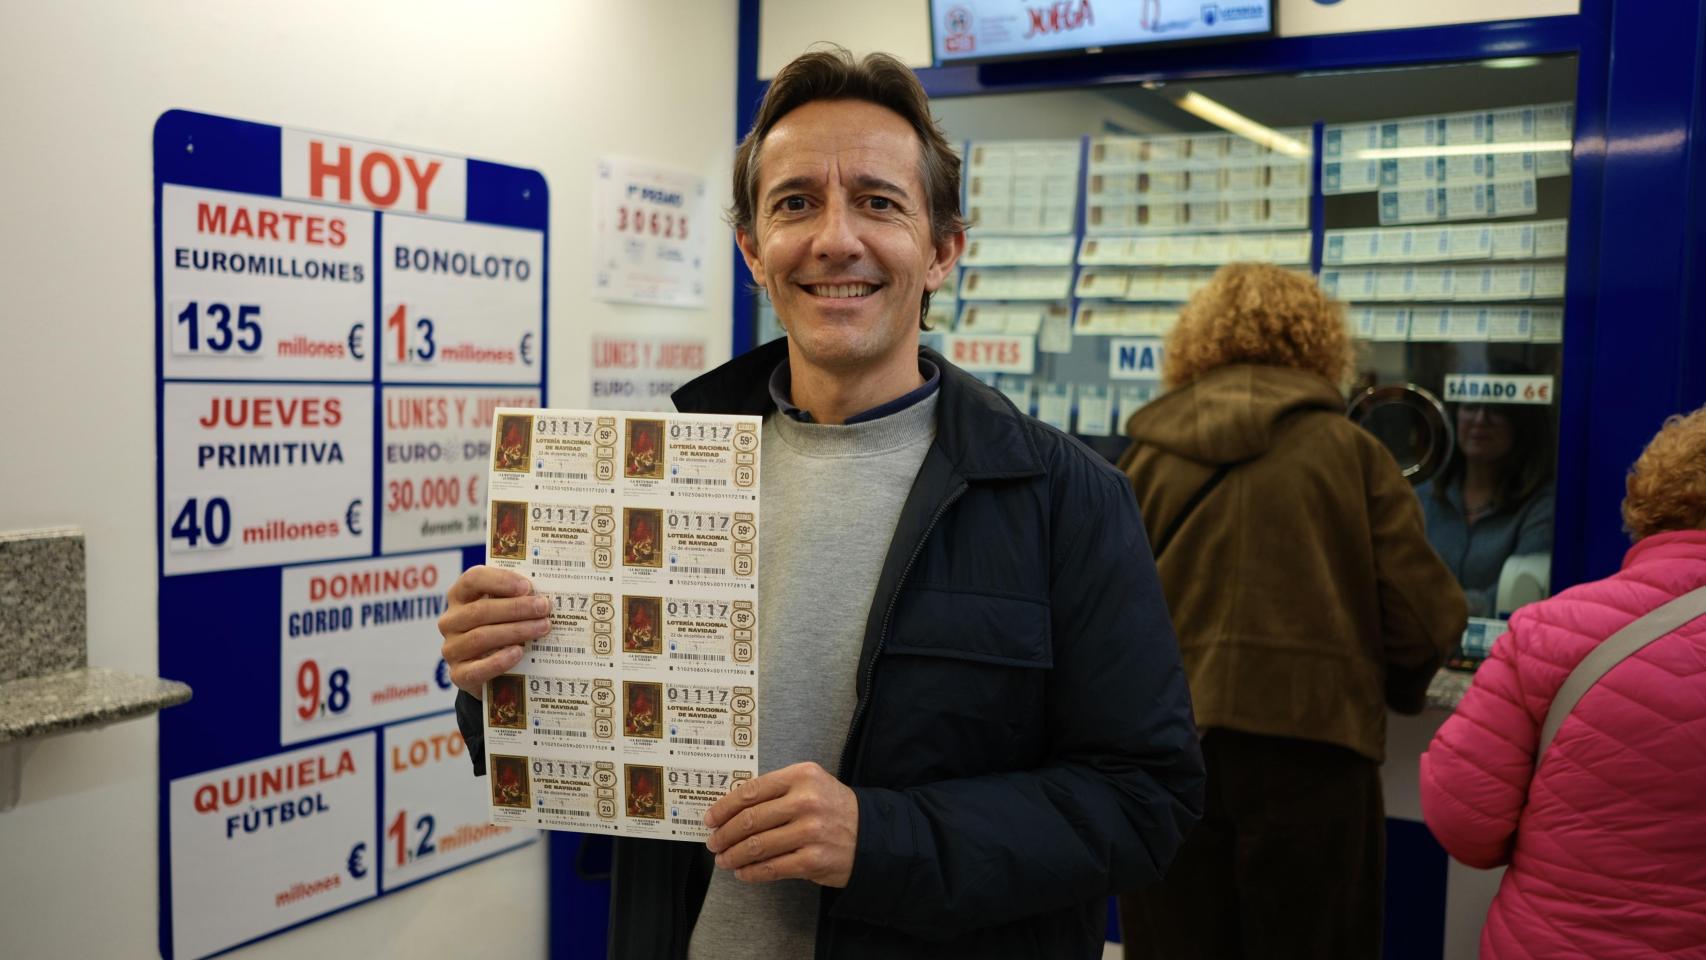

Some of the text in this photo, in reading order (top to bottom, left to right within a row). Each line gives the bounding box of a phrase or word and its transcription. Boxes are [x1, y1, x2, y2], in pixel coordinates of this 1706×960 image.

[309, 140, 441, 216] HOY
[197, 202, 347, 247] MARTES
[617, 206, 689, 240] 30625
[174, 248, 364, 283] EUROMILLONES
[394, 246, 530, 282] BONOLOTO
[178, 301, 365, 361] 135 millones €
[388, 304, 534, 365] 1,3 millones €
[593, 339, 637, 369] LUNES
[656, 342, 705, 370] JUEVES
[954, 340, 1020, 365] REYES
[1448, 380, 1516, 398] SÁBADO
[199, 398, 342, 429] JUEVES
[387, 397, 448, 429] LUNES
[456, 398, 465, 427] Y
[537, 420, 593, 434] 01117
[671, 425, 731, 438] 01117
[198, 443, 344, 469] PRIMITIVA
[387, 443, 442, 463] EURO
[388, 475, 478, 512] 30.000 €
[171, 497, 363, 547] 40 millones €
[532, 508, 589, 521] 01117
[668, 515, 728, 528] 01117
[739, 561, 748, 569] 20
[310, 564, 438, 602] DOMINGO
[546, 596, 588, 609] 117
[668, 603, 728, 616] 01117
[289, 606, 353, 639] GORDO
[297, 659, 350, 719] 9,8
[372, 683, 429, 703] millones
[530, 680, 588, 694] 01117
[668, 688, 728, 702] 01117
[193, 749, 356, 815] QUINIELA
[533, 762, 591, 776] 01117
[668, 772, 728, 785] 01117
[226, 791, 329, 839] FÚTBOL
[389, 811, 436, 866] 1,2
[275, 841, 367, 907] millones €
